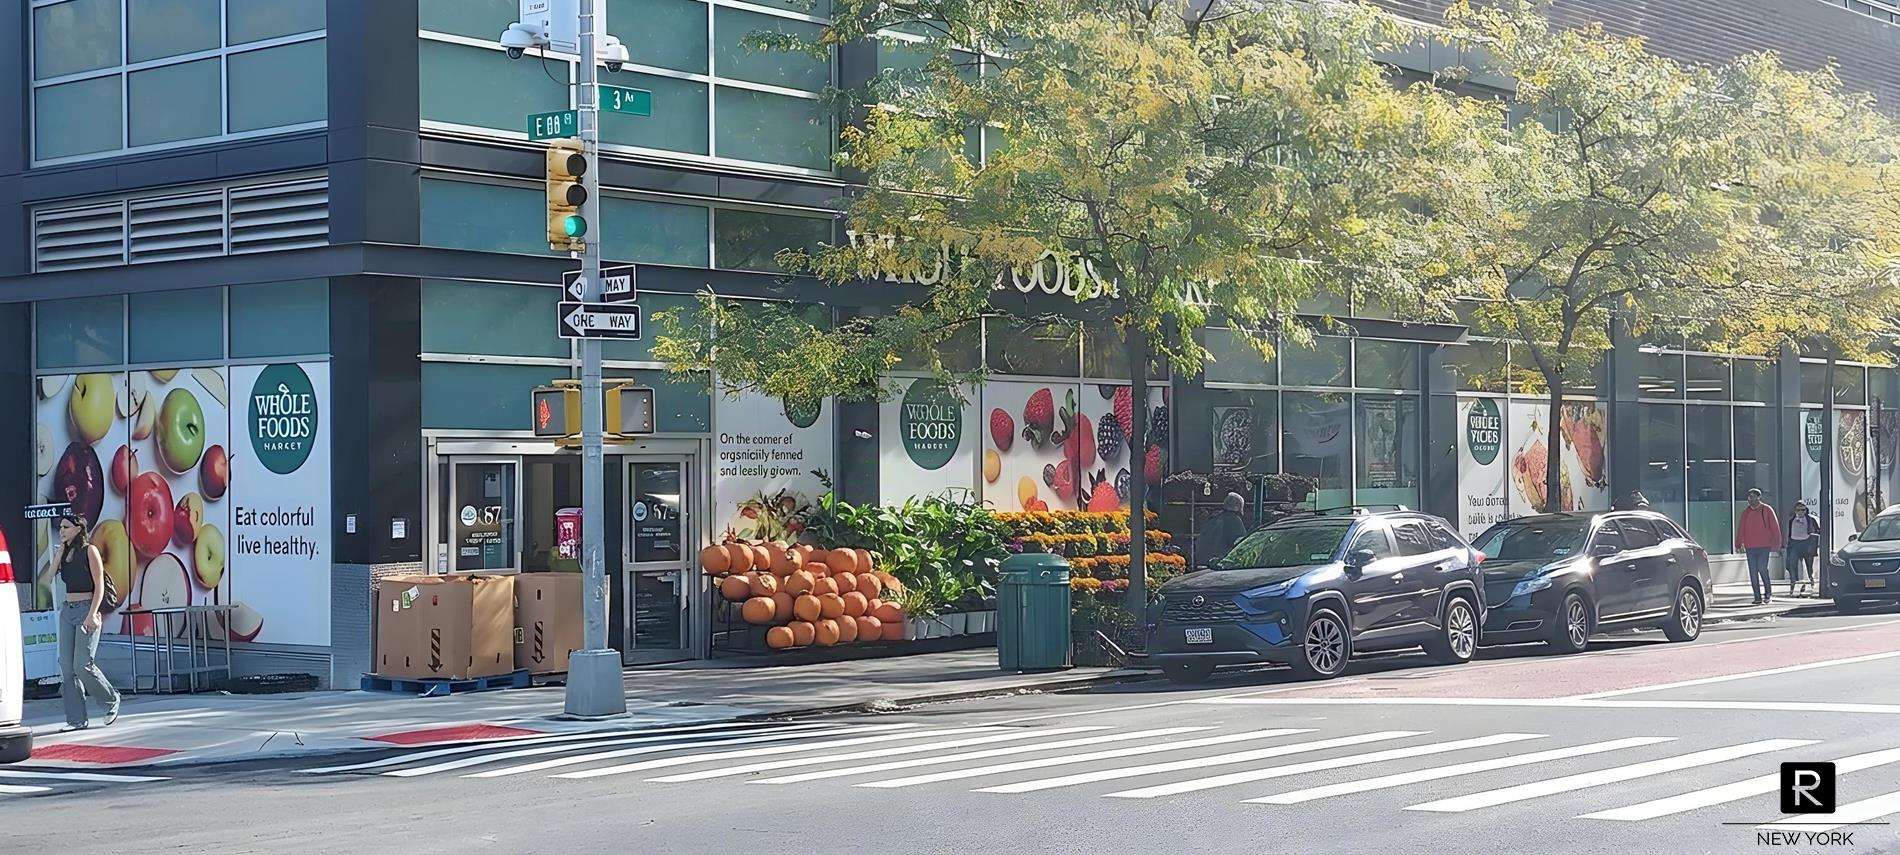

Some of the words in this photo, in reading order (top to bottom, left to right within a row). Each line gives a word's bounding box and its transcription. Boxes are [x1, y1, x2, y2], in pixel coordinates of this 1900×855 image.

[613, 90, 621, 110] 3
[536, 117, 543, 137] E
[609, 315, 632, 328] WAY
[255, 393, 311, 416] WHOLE
[258, 416, 310, 438] FOODS
[720, 433, 734, 445] On
[235, 506, 257, 526] Eat
[260, 506, 314, 526] colorful
[237, 534, 261, 554] live
